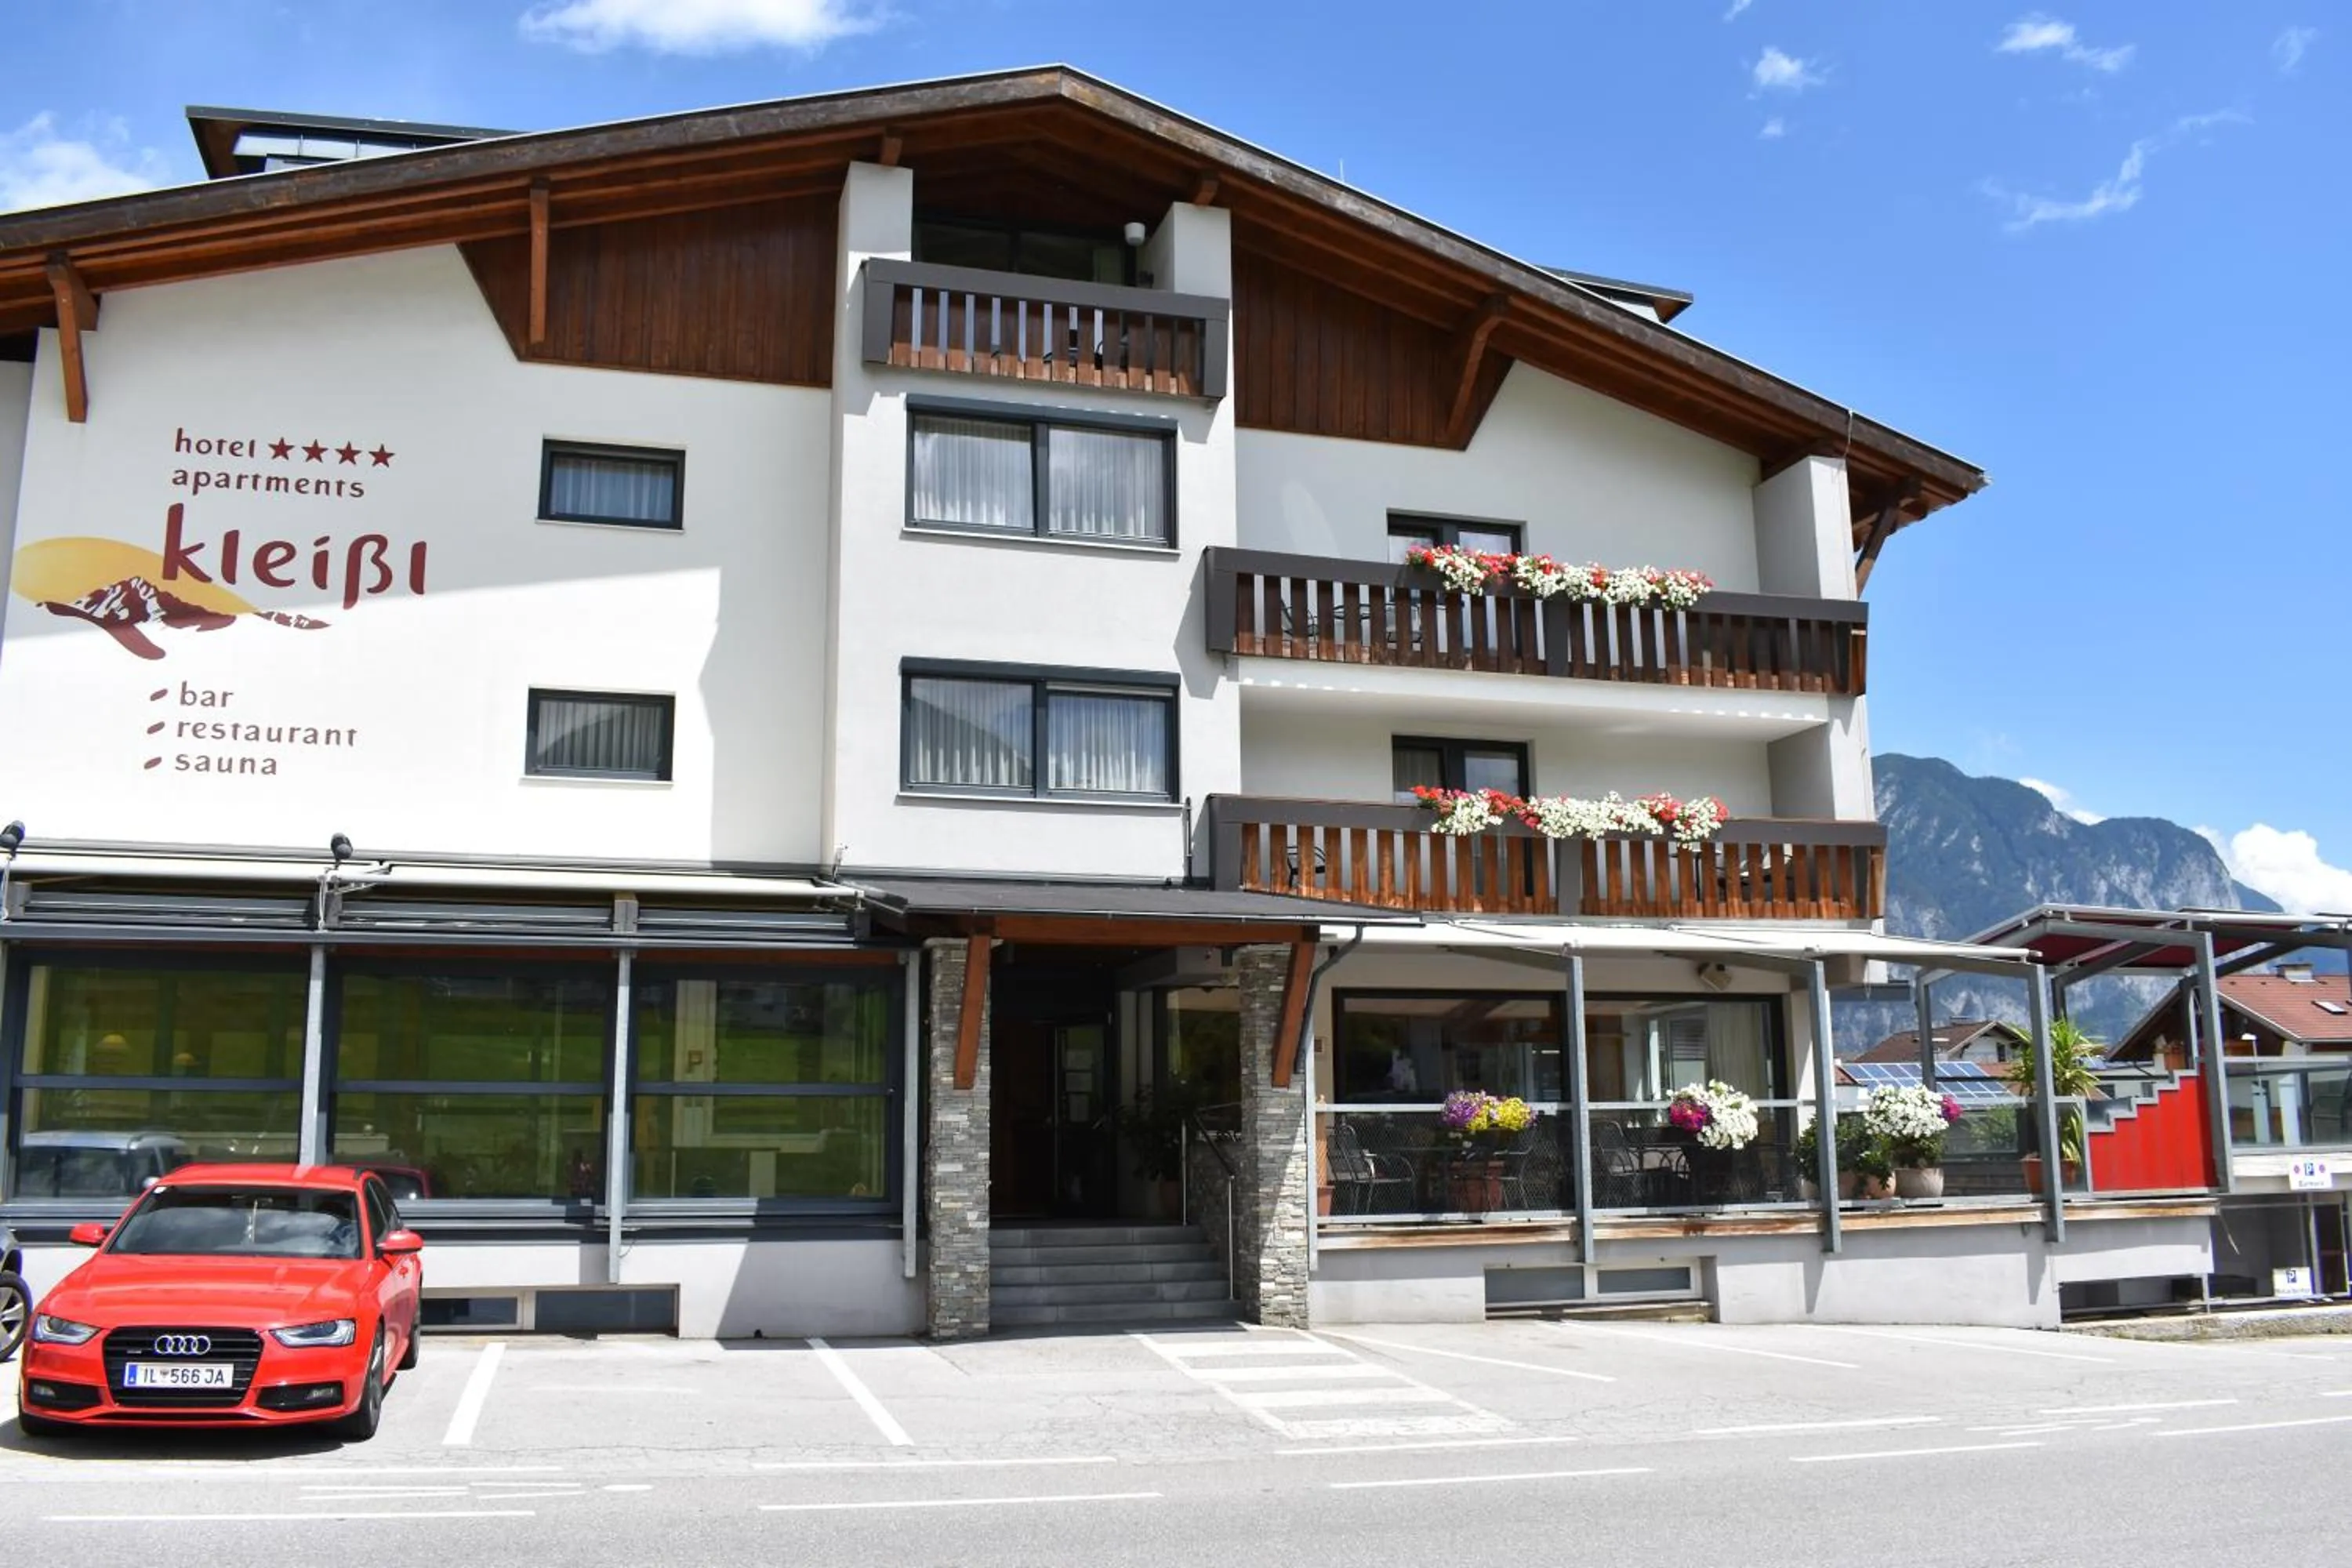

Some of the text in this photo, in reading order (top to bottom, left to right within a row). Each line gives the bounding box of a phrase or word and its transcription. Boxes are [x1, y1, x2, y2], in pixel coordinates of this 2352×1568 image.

[174, 427, 256, 458] hotel
[171, 468, 365, 498] apartments
[162, 502, 427, 610] kleißl
[179, 680, 234, 708] bar
[176, 720, 358, 747] restaurant
[174, 753, 278, 775] sauna
[143, 1367, 225, 1385] IL 566 JA
